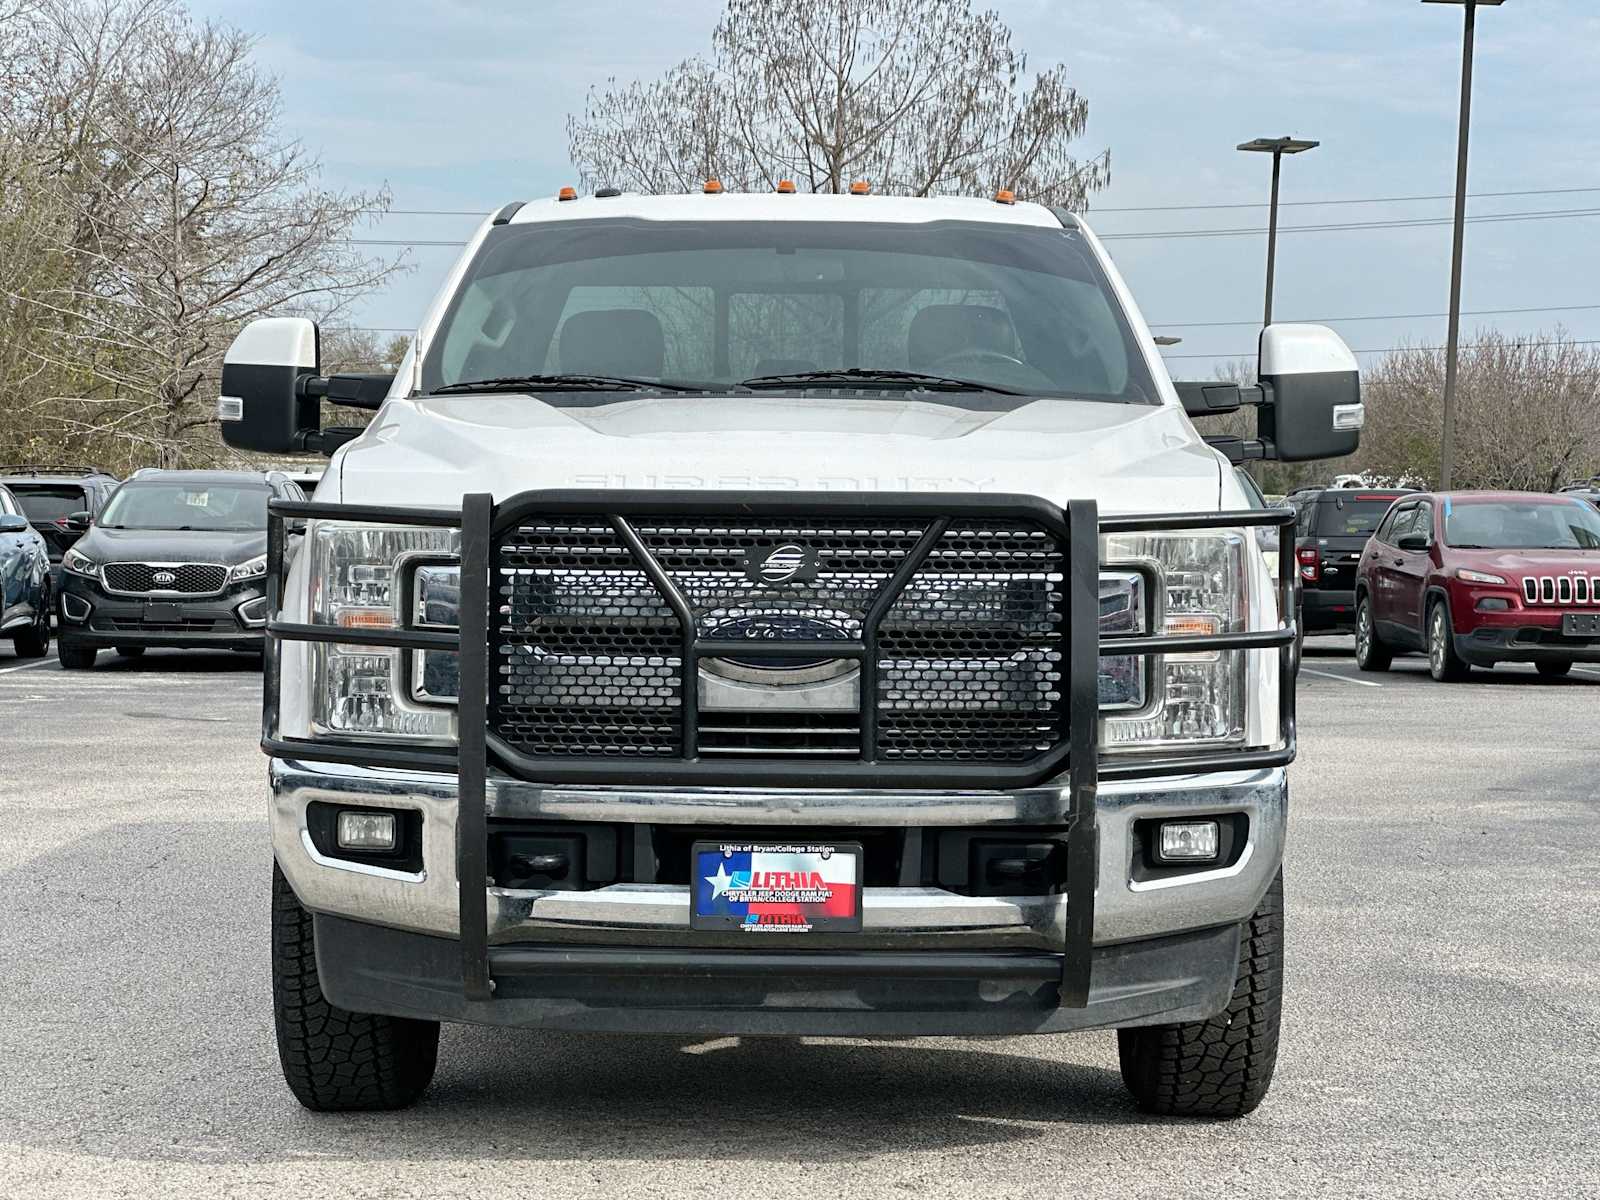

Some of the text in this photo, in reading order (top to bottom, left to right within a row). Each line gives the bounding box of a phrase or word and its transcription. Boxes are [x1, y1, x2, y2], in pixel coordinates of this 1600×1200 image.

[719, 844, 835, 854] Lithia of Bryan/College Station
[750, 871, 828, 890] LITHIA
